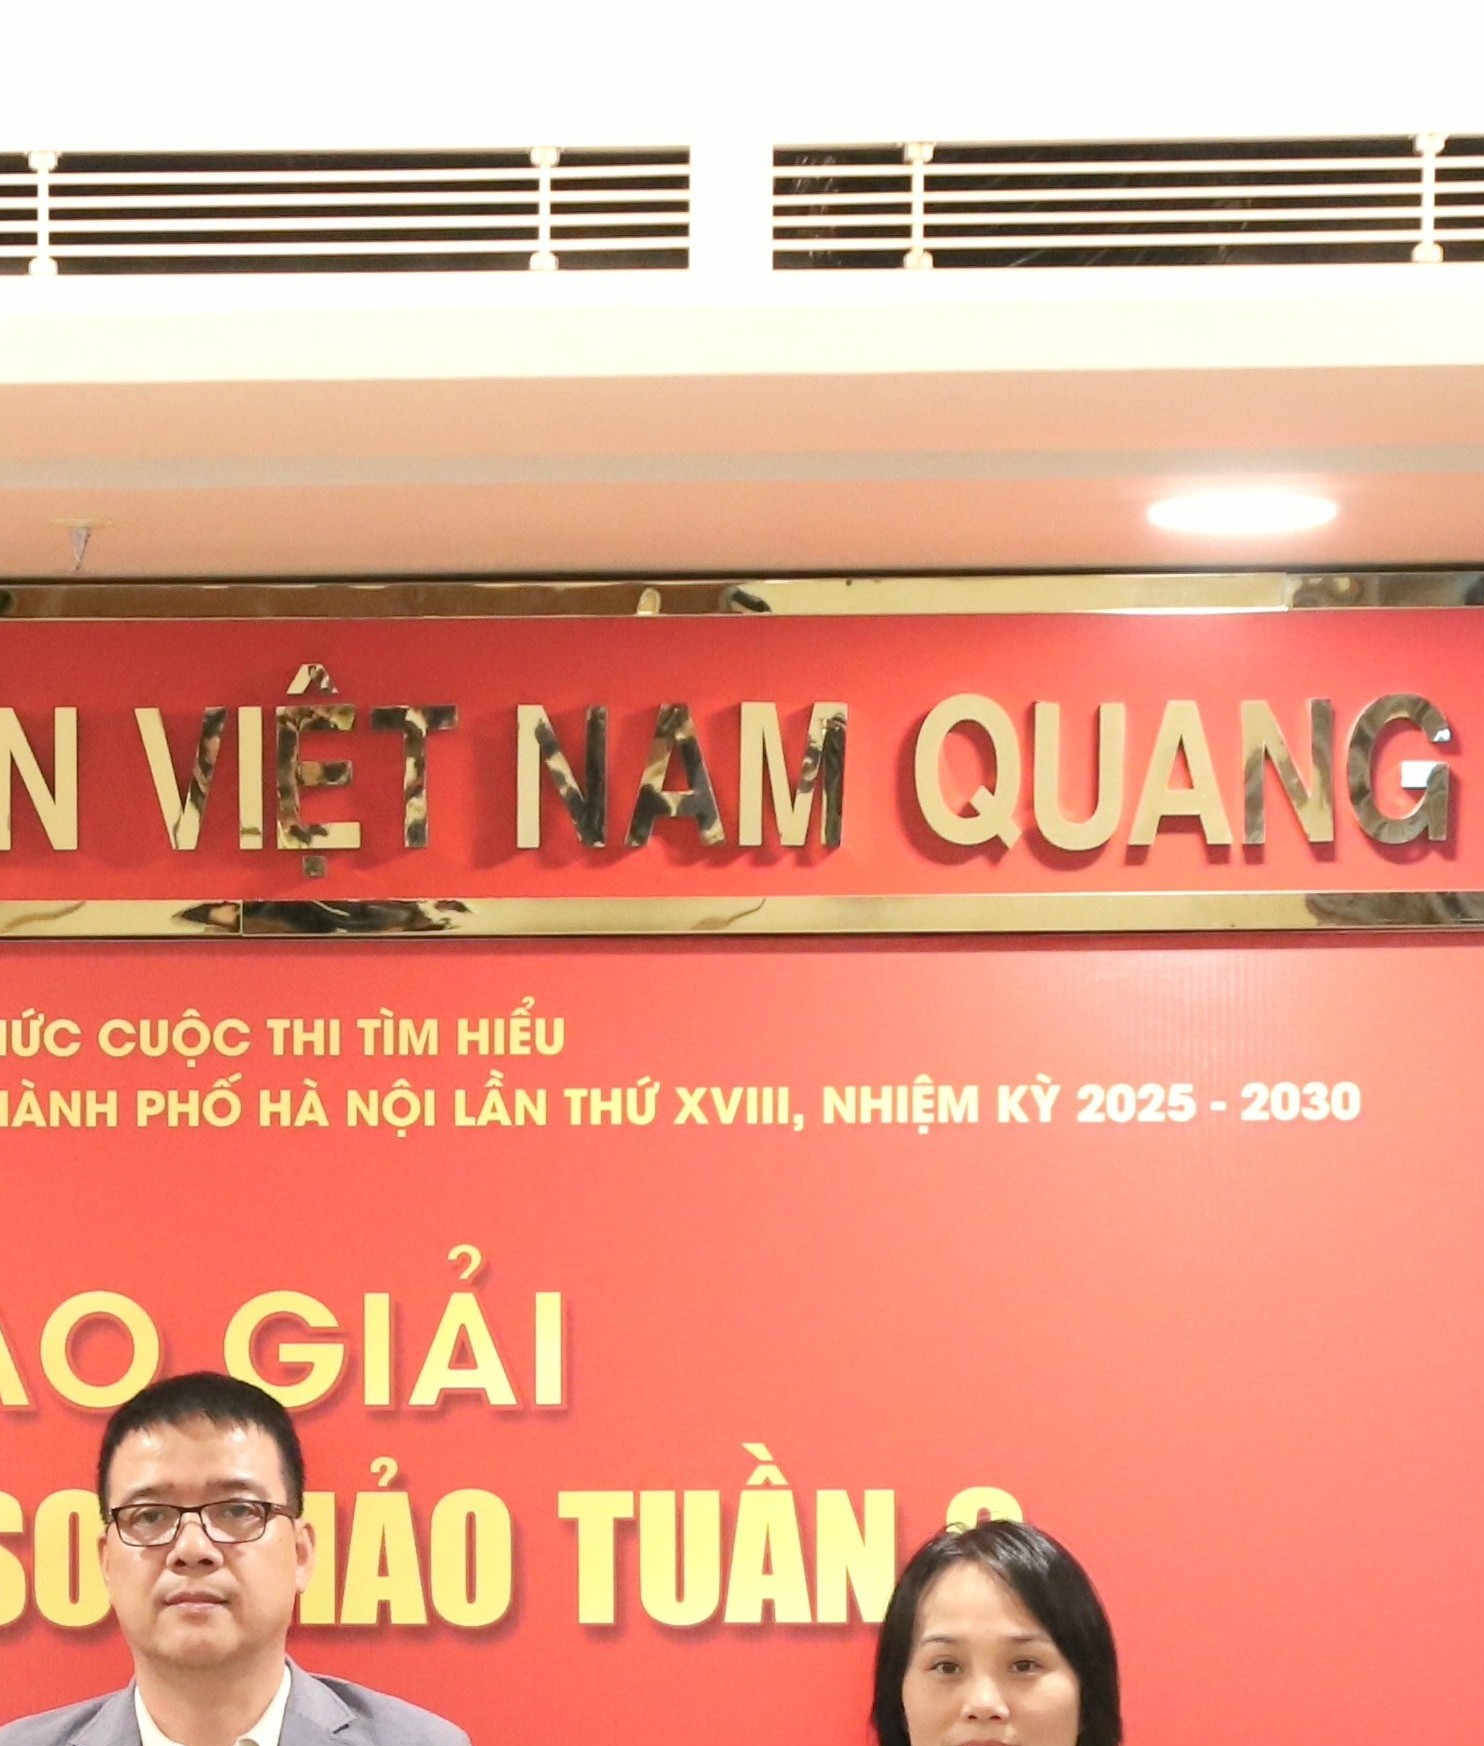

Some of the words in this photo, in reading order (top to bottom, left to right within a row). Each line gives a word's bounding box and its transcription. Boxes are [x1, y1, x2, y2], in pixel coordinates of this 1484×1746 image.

[135, 663, 458, 877] VIỆT
[516, 702, 847, 848] NAM
[914, 694, 1450, 851] QUANG
[100, 1010, 250, 1068] CUỘC
[268, 1021, 341, 1057] THI
[359, 1010, 439, 1057] TÌM
[459, 997, 565, 1057] HIỂU
[138, 1076, 243, 1128] PHỐ
[261, 1080, 330, 1127] HÀ
[348, 1081, 436, 1138] NỘI
[456, 1070, 548, 1127] LẦN
[564, 1077, 662, 1127] THỨ
[674, 1087, 805, 1132] XVIII,
[823, 1074, 979, 1134] NHIỆM
[997, 1073, 1061, 1124] KỲ
[1077, 1083, 1197, 1123] 2025
[1210, 1100, 1227, 1112] -
[1241, 1081, 1362, 1122] 2030
[224, 1244, 563, 1409] GIẢI
[558, 1442, 896, 1627] TUẦN
